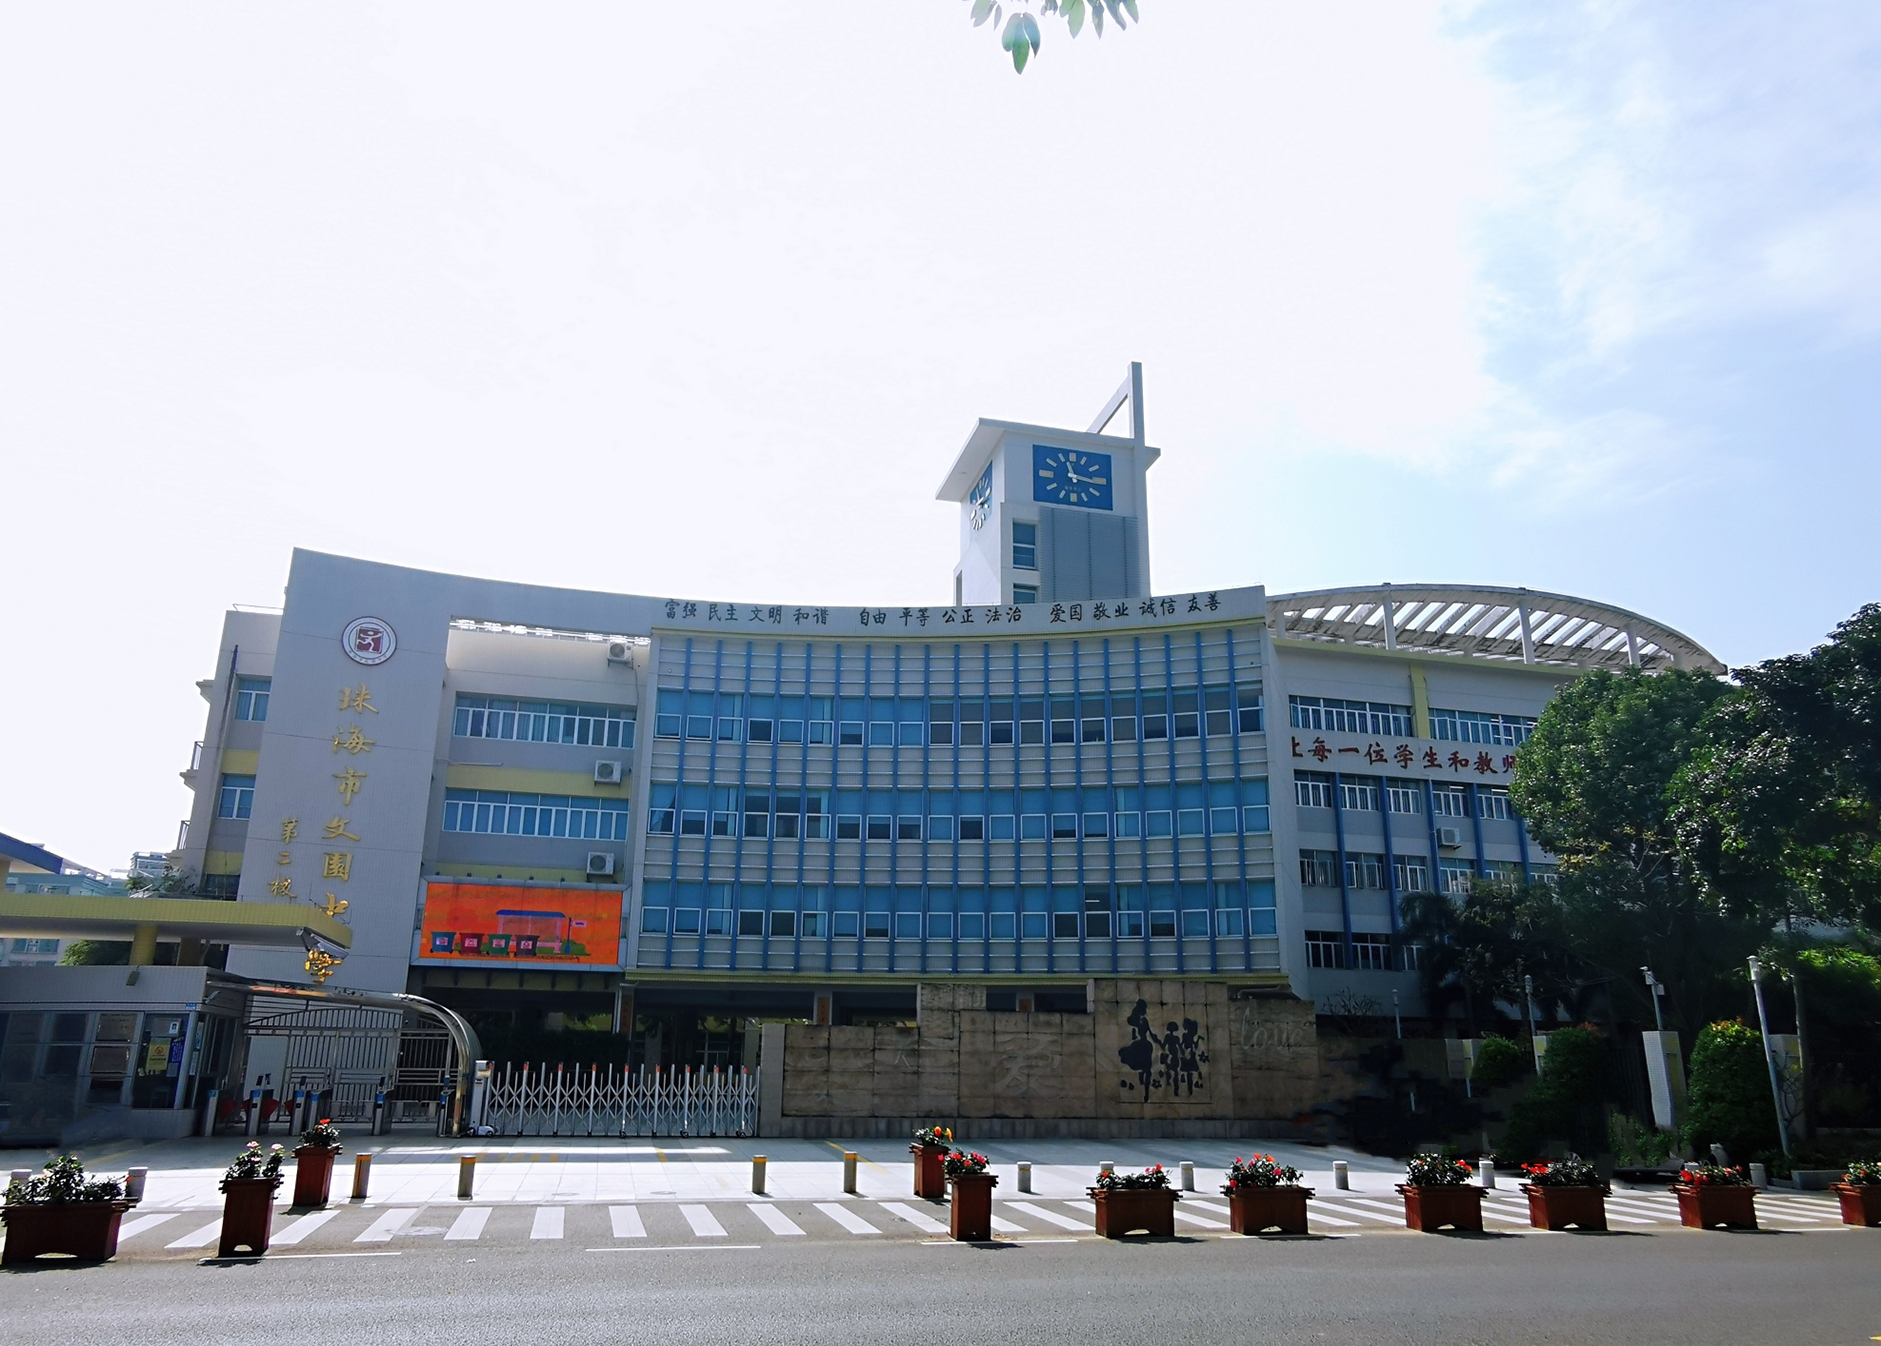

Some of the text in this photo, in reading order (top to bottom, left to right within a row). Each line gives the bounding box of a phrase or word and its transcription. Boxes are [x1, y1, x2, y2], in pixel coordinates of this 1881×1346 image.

[665, 591, 1222, 628] 富强 民主 文明 和谐 自由 平等 公正 法治 爱国 敬业 诚信 友善
